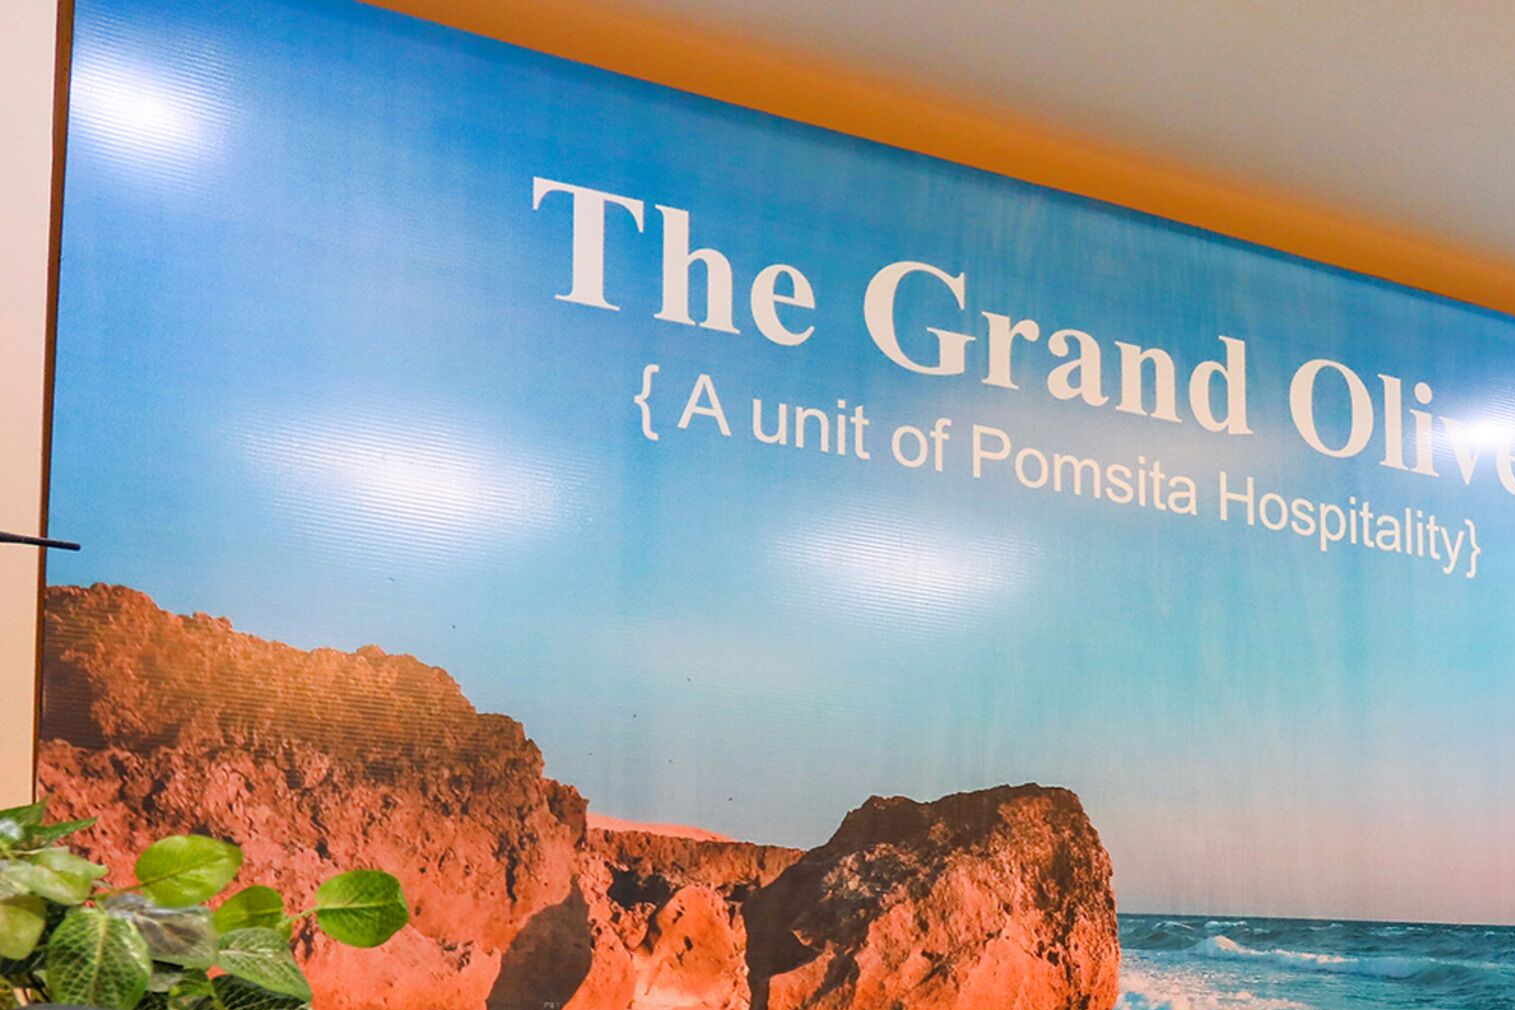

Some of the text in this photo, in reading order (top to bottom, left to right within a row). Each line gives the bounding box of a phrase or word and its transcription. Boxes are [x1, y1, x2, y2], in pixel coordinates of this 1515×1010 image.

[532, 176, 816, 346] The
[863, 260, 1254, 436] Grand
[752, 398, 870, 461] unit
[891, 417, 952, 473] of
[972, 424, 1197, 516] Pomsita
[1219, 471, 1482, 579] Hospitality}
